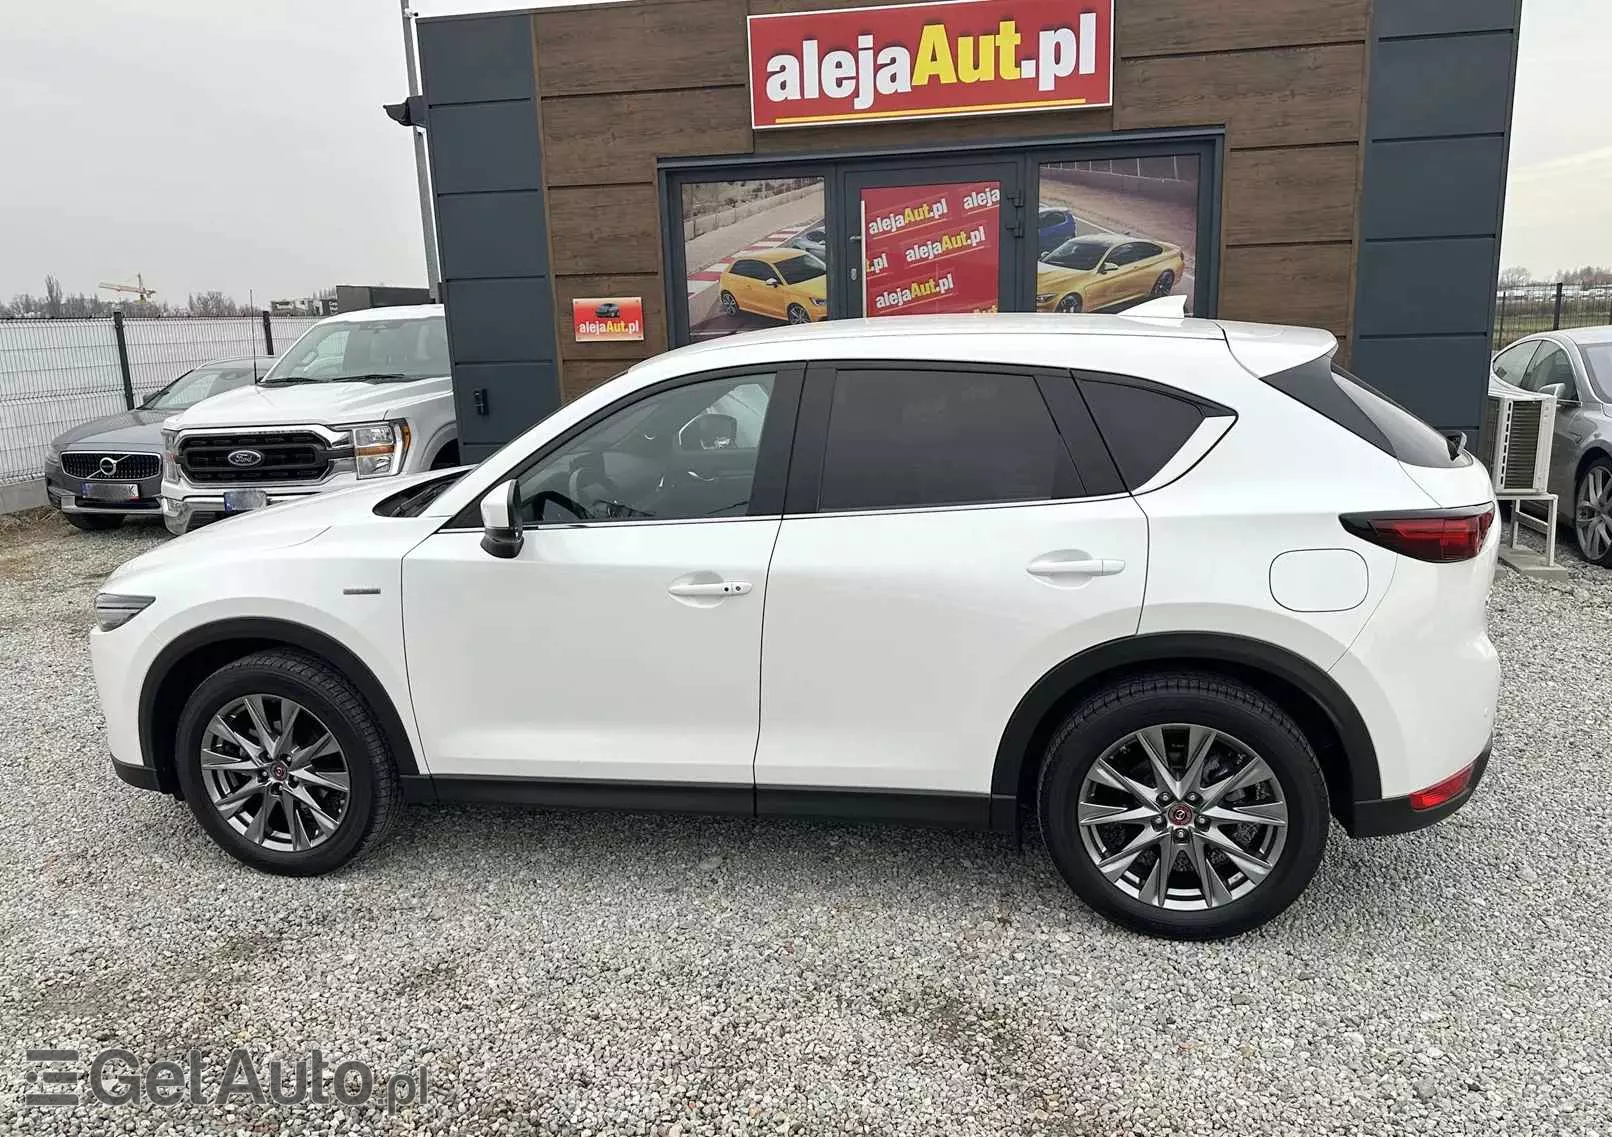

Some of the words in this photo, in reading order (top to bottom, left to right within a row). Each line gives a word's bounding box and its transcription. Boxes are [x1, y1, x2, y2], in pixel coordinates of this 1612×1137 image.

[766, 12, 1097, 110] alejaAut.pl
[868, 198, 948, 234] alejaAut.pl
[905, 226, 986, 261] alejaAut.pl
[875, 273, 954, 308] alejaAut.pl
[579, 320, 639, 335] alejaAut.pl
